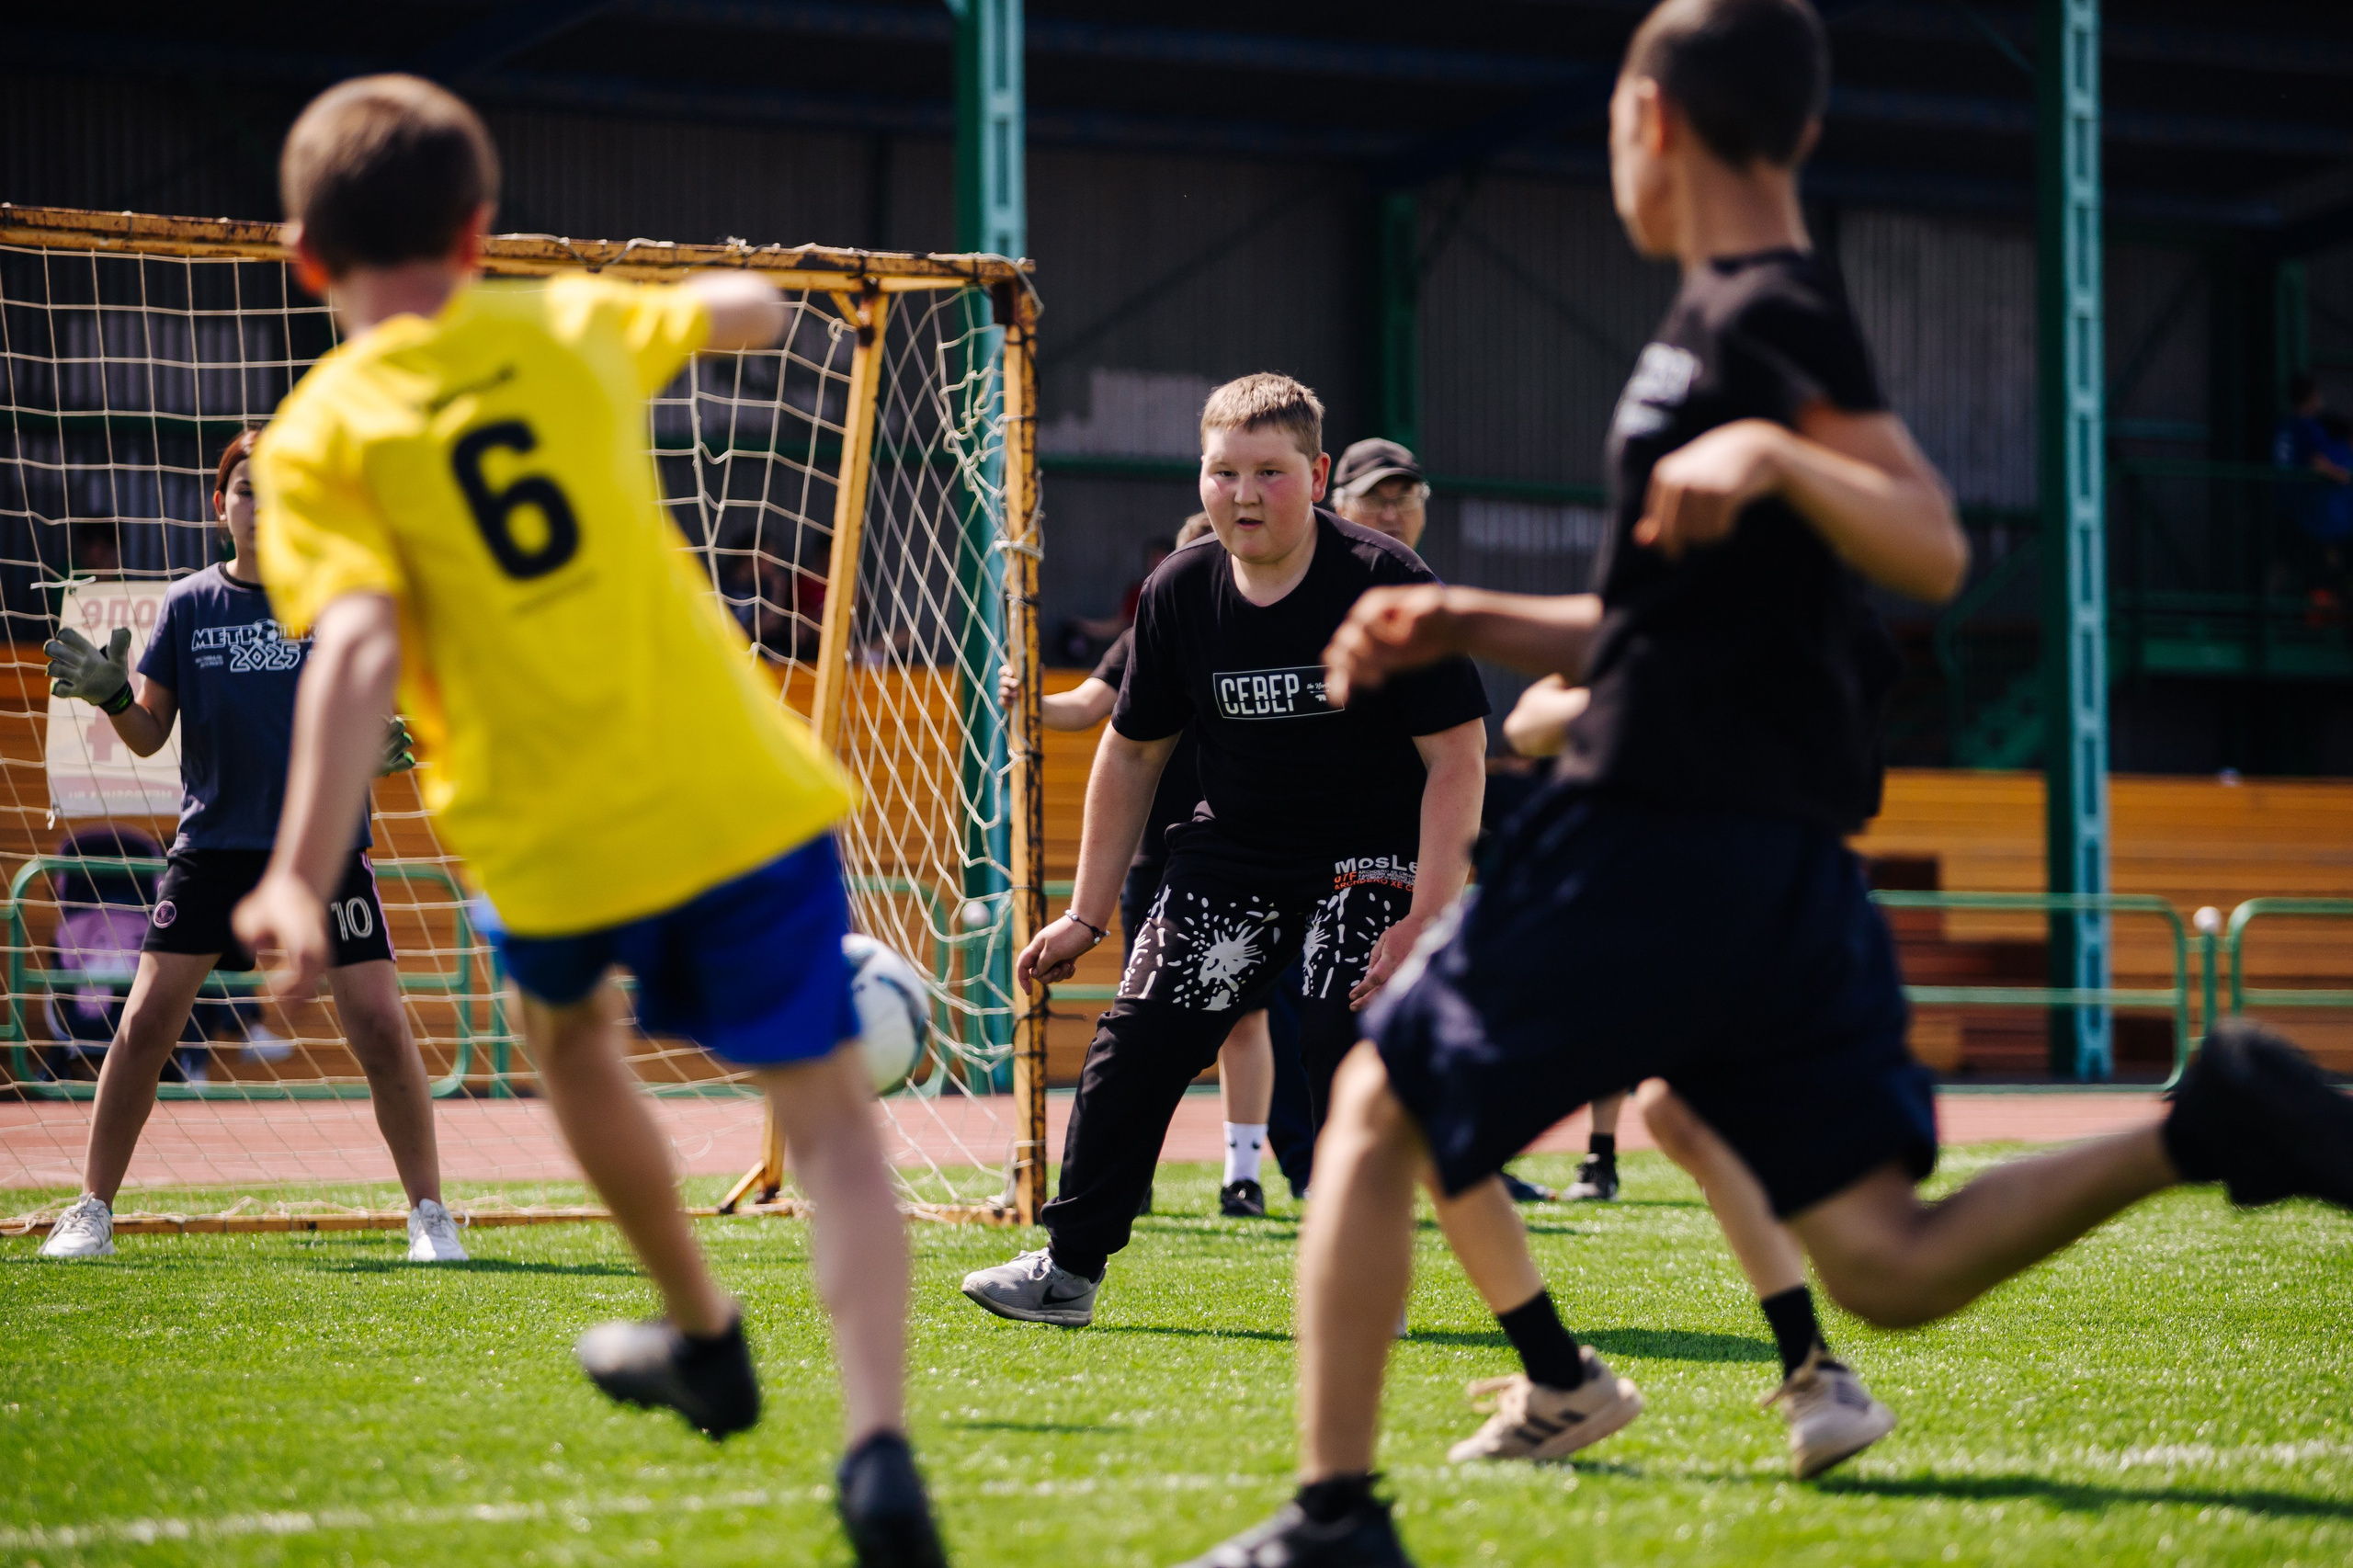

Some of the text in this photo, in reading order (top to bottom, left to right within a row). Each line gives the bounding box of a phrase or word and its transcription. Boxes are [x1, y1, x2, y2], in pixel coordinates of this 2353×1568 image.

[451, 418, 581, 582] 6
[230, 641, 301, 673] 2025
[1221, 673, 1300, 715] СЕВЕР
[1391, 881, 1404, 889] XE
[330, 896, 373, 942] 10
